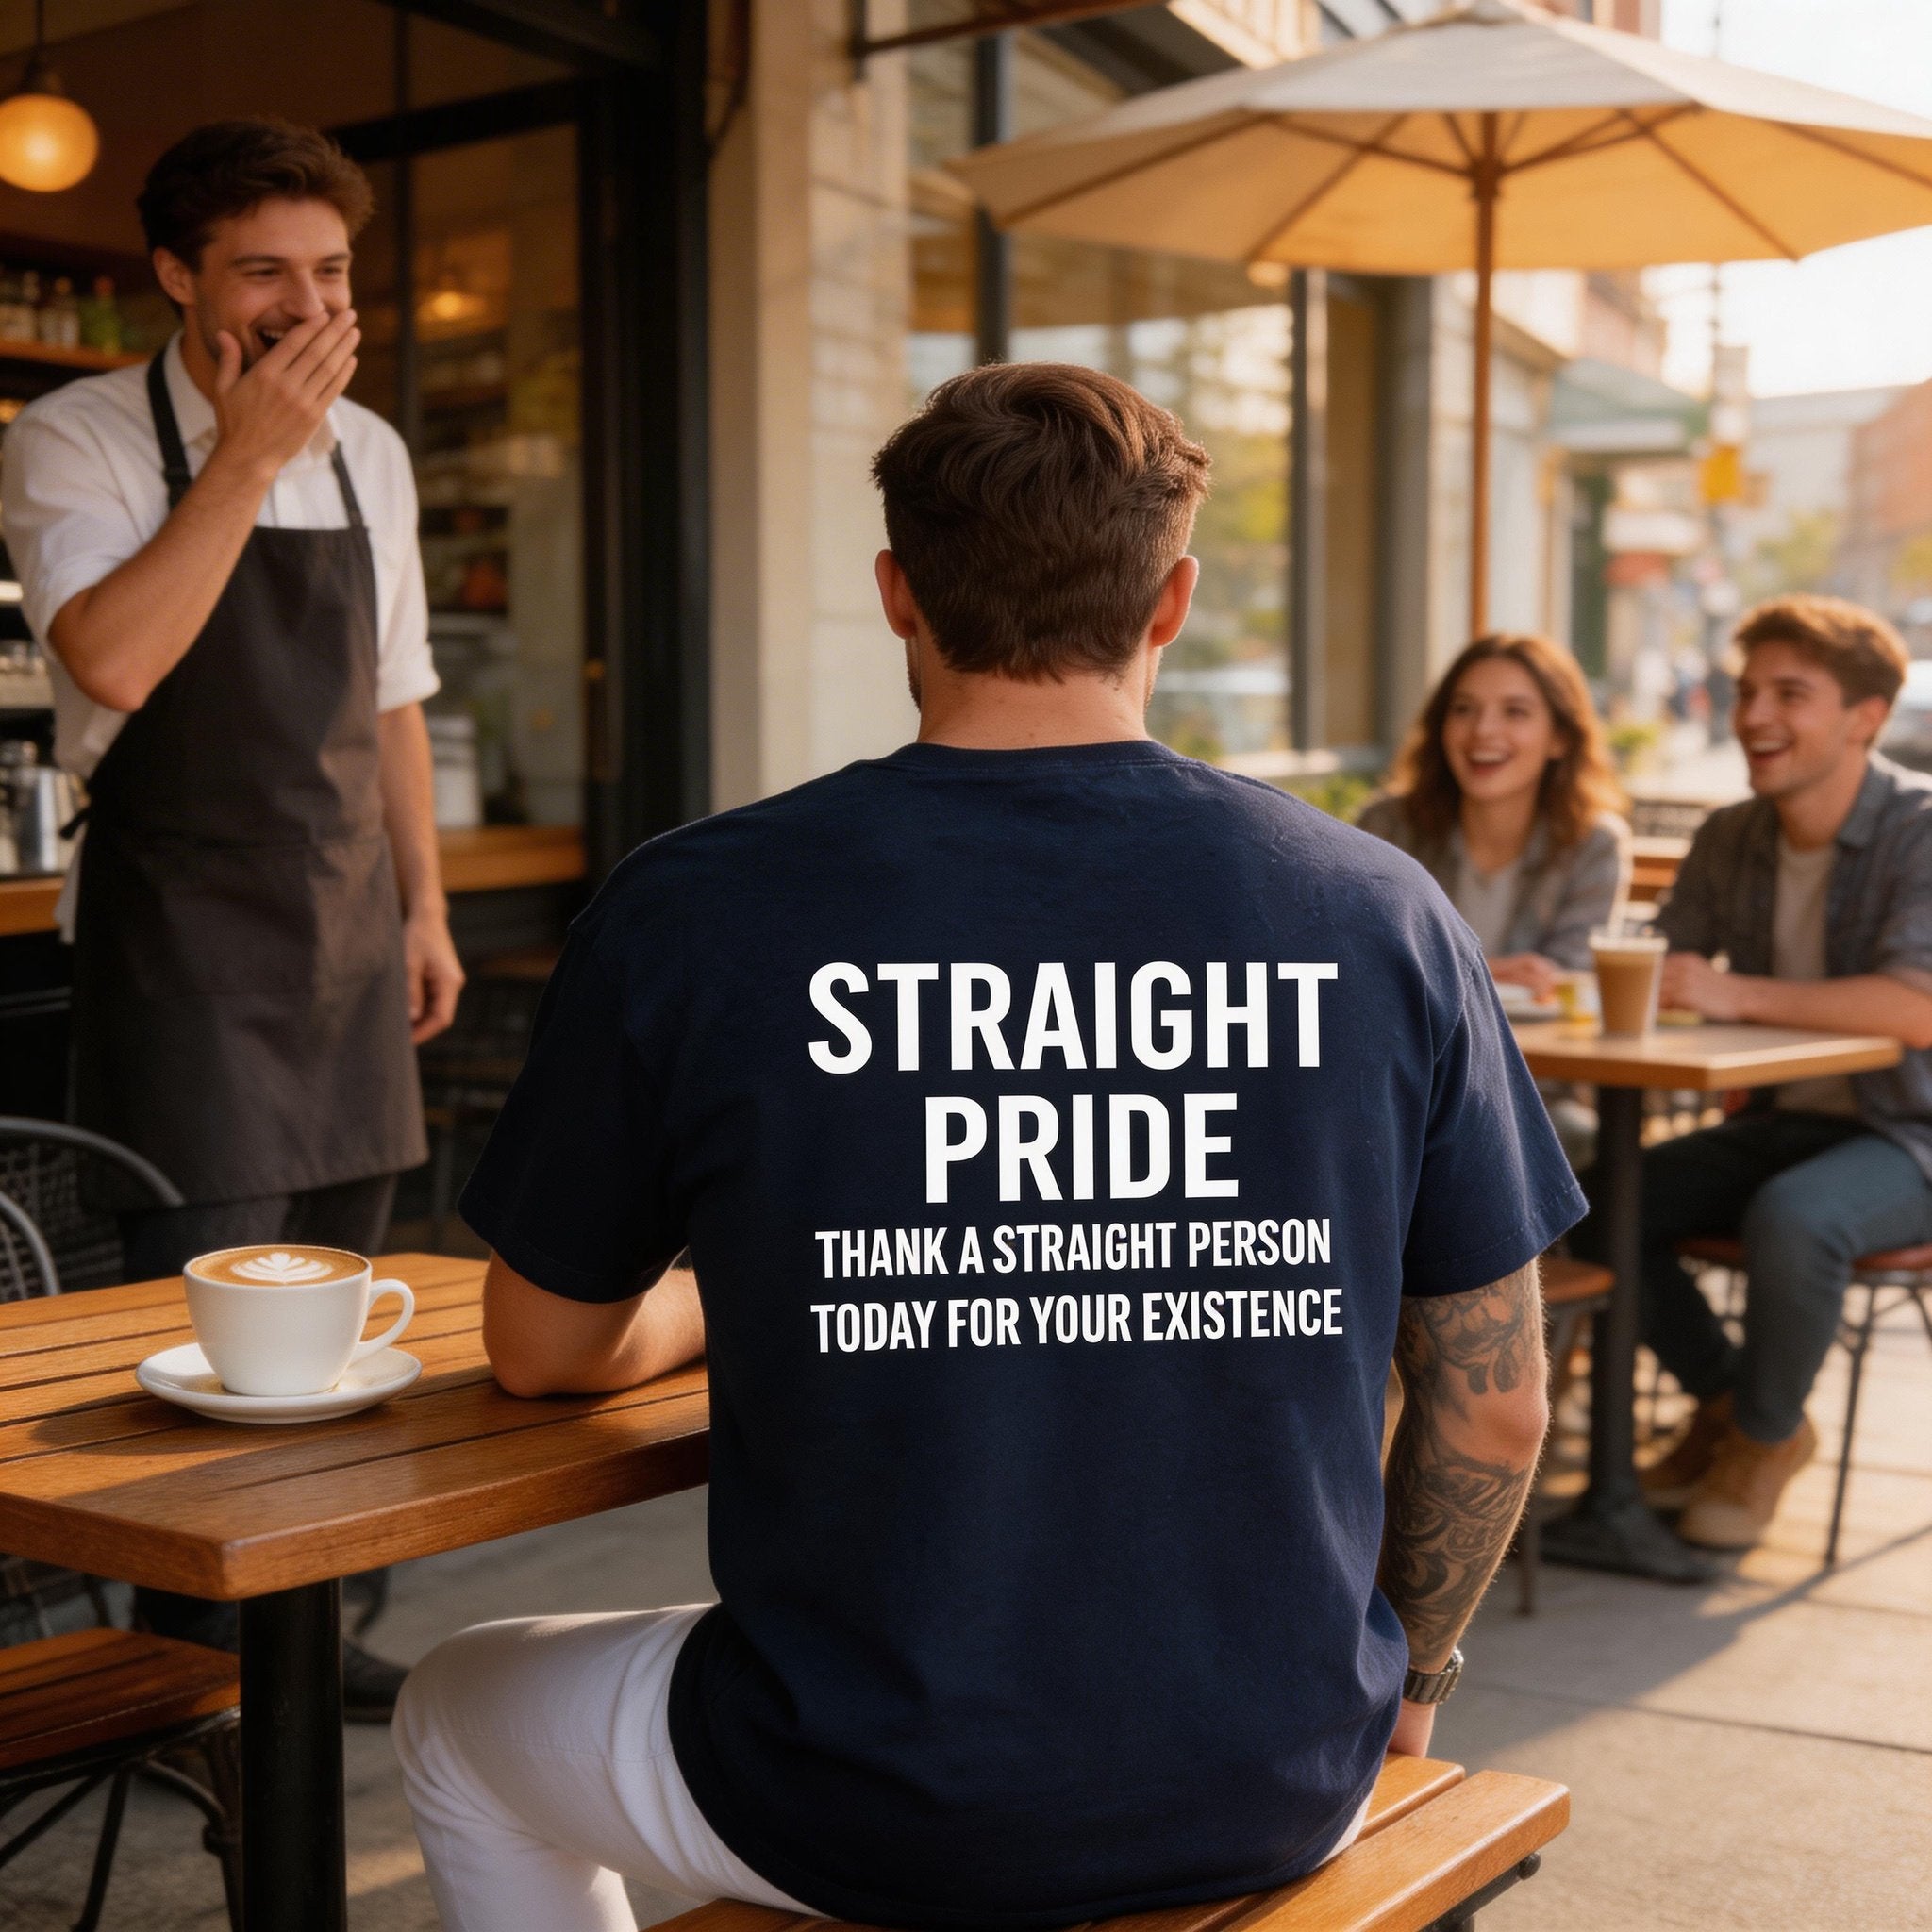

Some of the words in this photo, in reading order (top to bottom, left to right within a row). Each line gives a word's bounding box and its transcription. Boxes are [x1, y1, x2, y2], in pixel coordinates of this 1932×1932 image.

[808, 961, 1339, 1074] STRAIGHT
[925, 1093, 1239, 1204] PRIDE
[815, 1227, 950, 1278] THANK
[958, 1227, 985, 1274] A
[993, 1222, 1177, 1274] STRAIGHT
[1189, 1218, 1331, 1268] PERSON
[810, 1300, 937, 1353] TODAY
[948, 1298, 1021, 1347] FOR
[1029, 1294, 1132, 1344] YOUR
[1143, 1289, 1343, 1341] EXISTENCE
